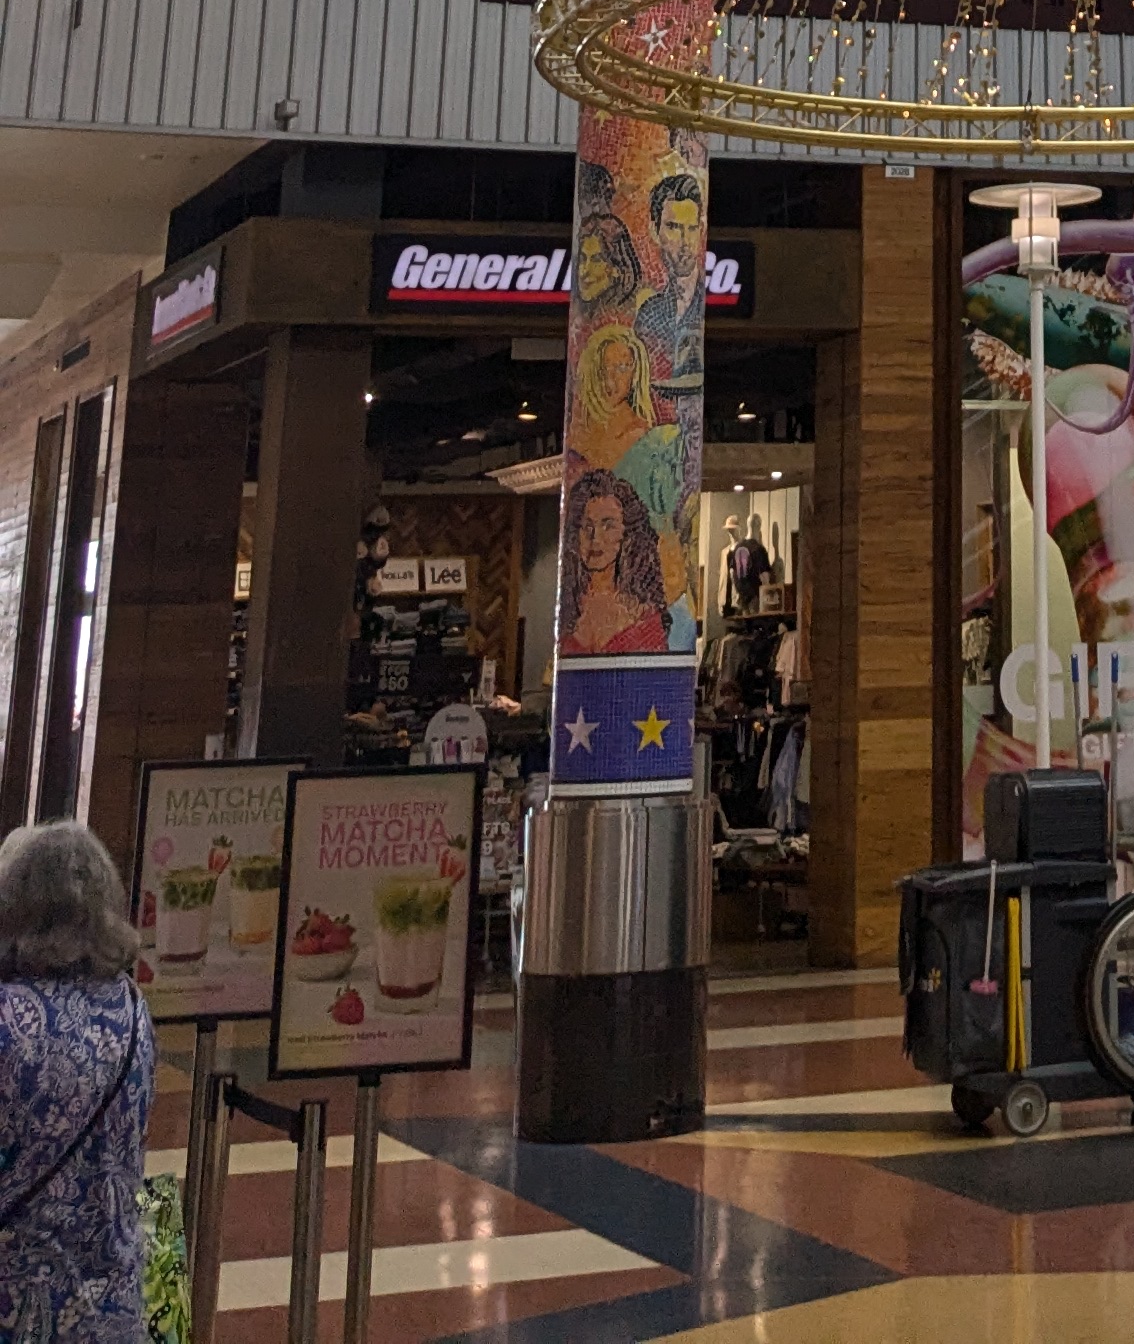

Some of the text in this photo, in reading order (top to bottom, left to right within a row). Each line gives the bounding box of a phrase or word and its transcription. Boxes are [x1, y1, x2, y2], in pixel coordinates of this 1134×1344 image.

[391, 245, 568, 291] General
[430, 567, 462, 584] Lee
[165, 785, 285, 812] MATCHA
[321, 800, 449, 821] STRAWBERRY
[164, 808, 286, 827] HAS ARRIVED
[320, 816, 449, 846] MATCHA
[318, 842, 443, 870] MOMENT
